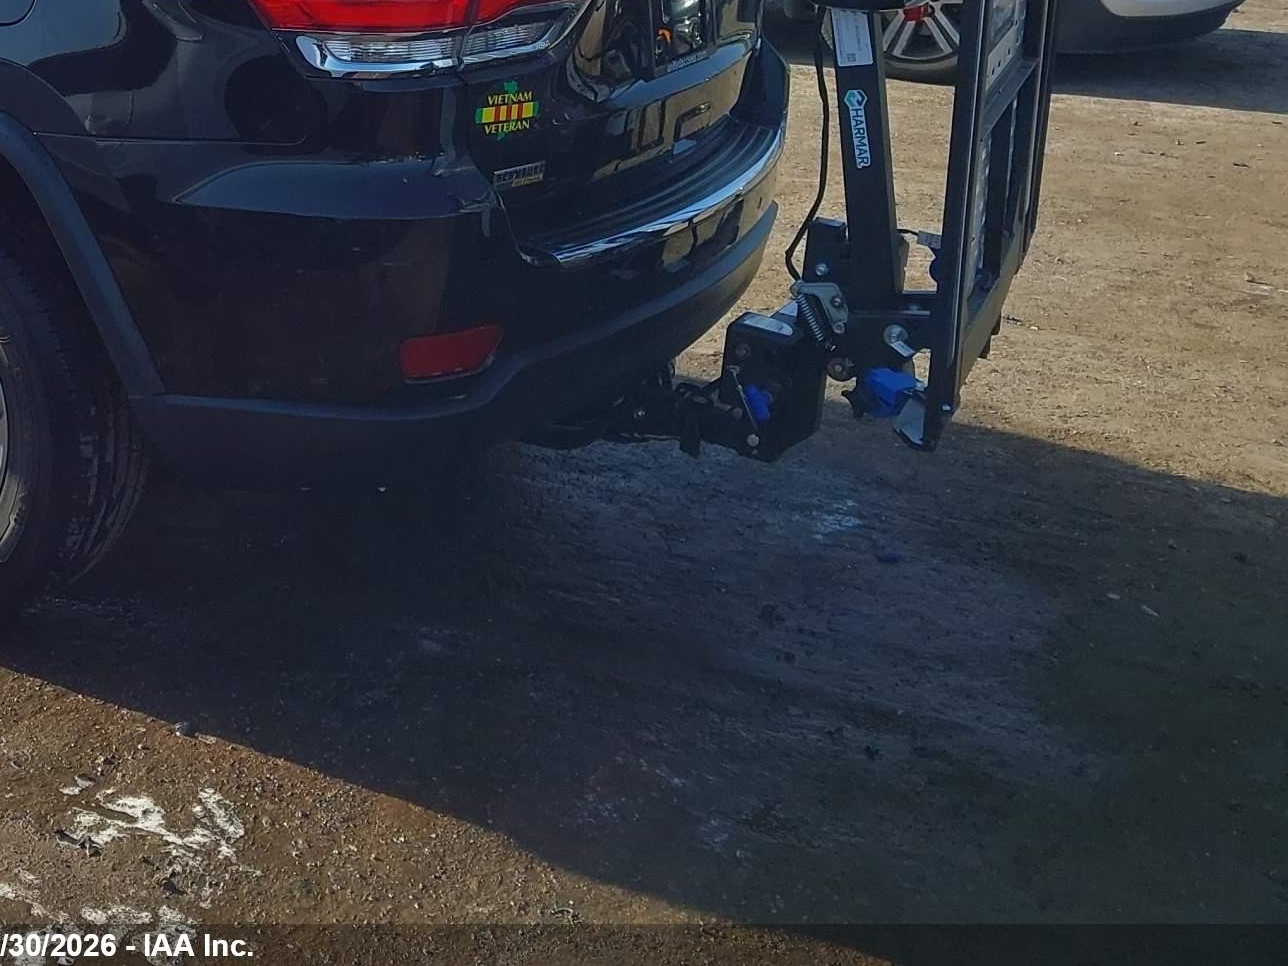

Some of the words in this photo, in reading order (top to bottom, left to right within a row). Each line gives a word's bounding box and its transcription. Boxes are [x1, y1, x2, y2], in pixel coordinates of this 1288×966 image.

[487, 91, 533, 106] VIETNAM
[484, 119, 530, 135] VETERAN
[850, 107, 870, 166] HARMAR
